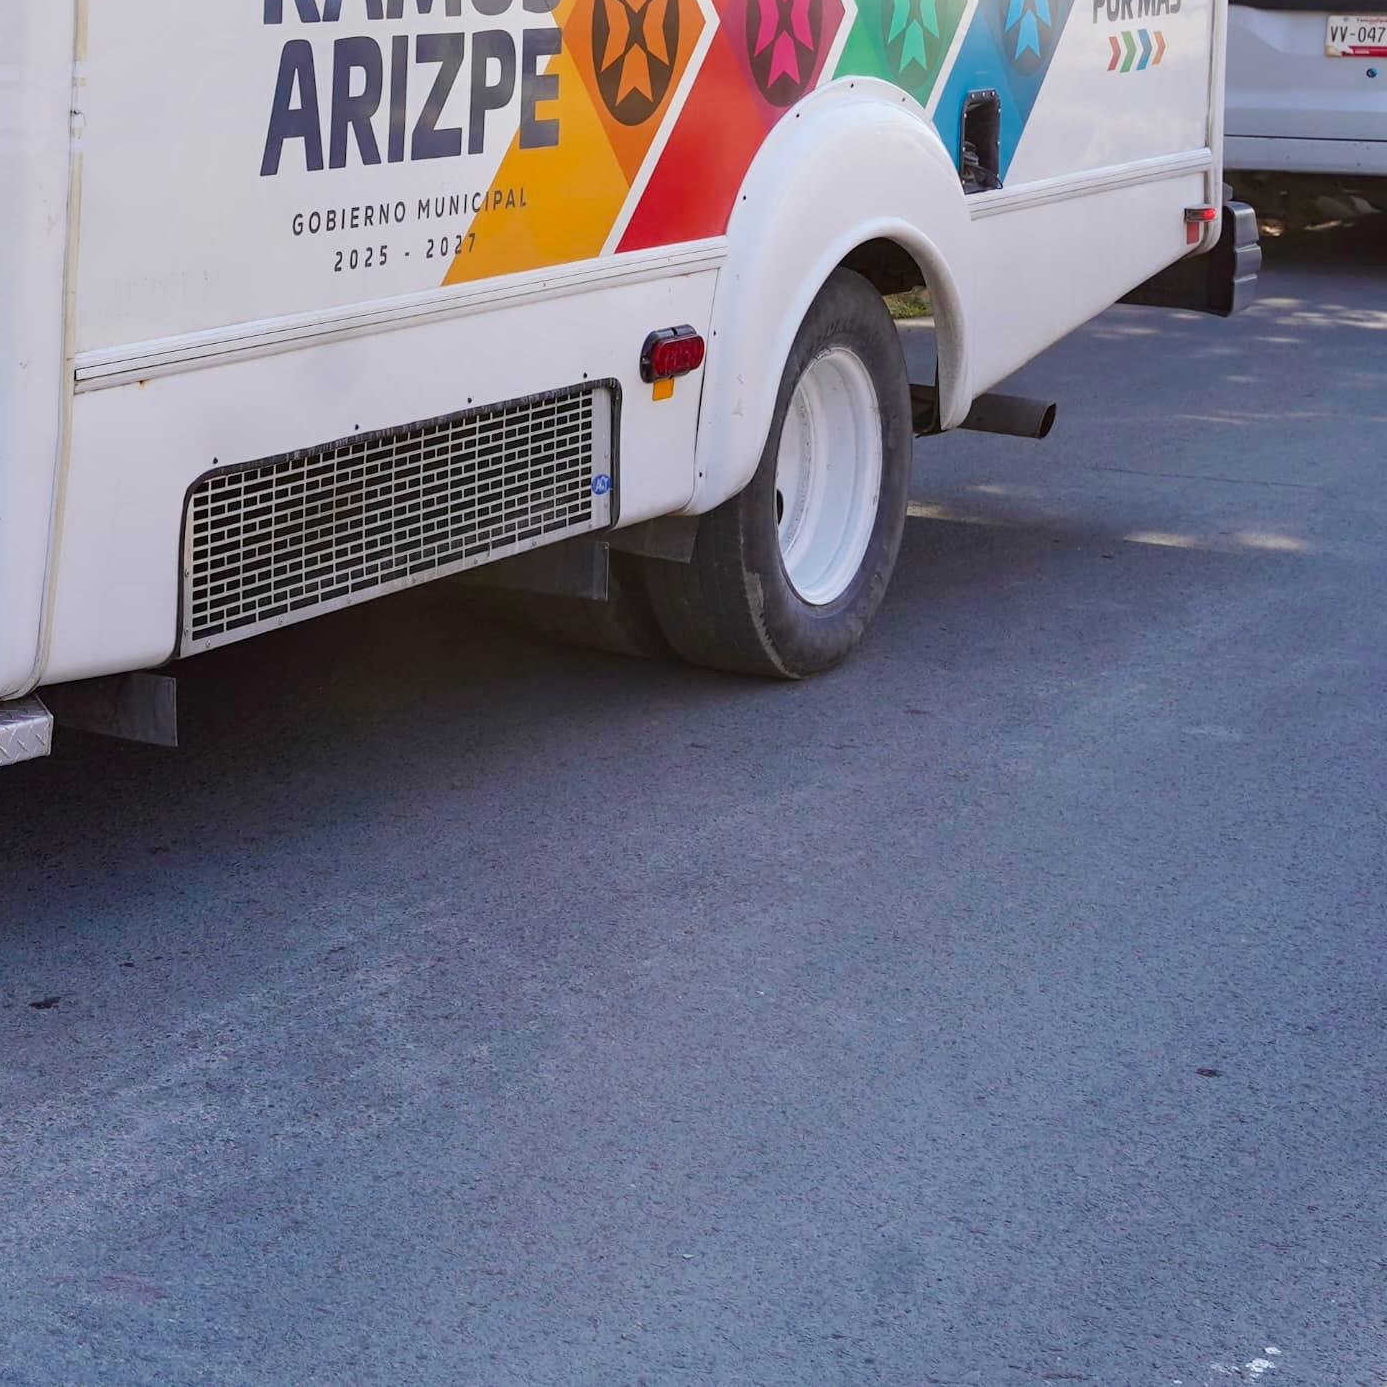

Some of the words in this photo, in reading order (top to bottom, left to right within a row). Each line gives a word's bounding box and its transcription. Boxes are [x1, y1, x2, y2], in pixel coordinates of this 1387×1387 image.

[260, 27, 563, 176] ARIZPE
[292, 202, 406, 236] GOBIERNO
[418, 187, 527, 220] MUNICIPAL
[334, 245, 388, 272] 2025
[426, 233, 476, 259] 2027
